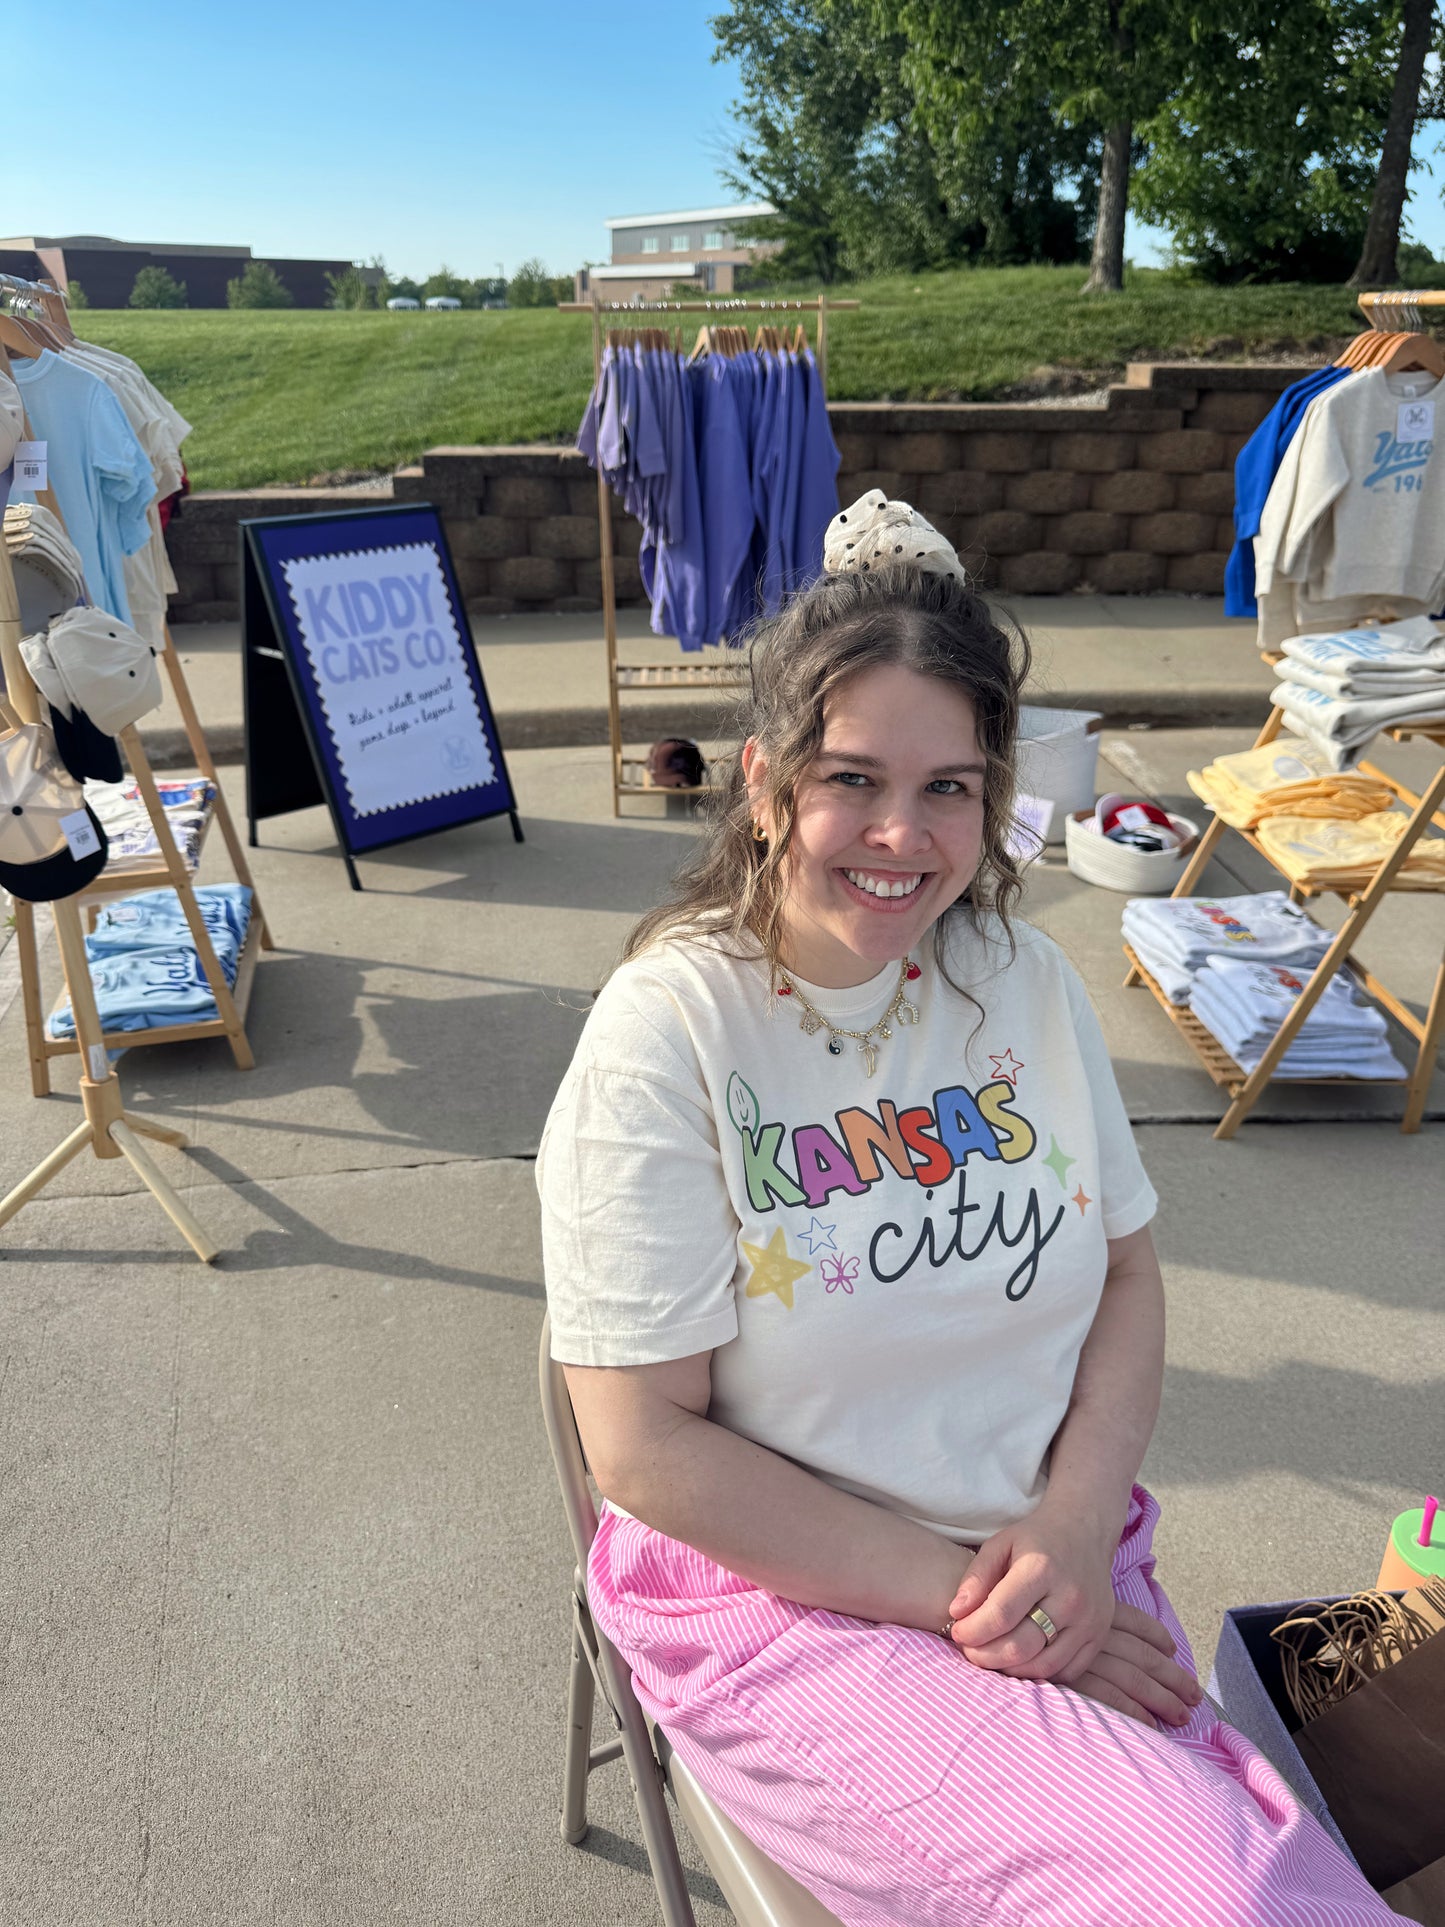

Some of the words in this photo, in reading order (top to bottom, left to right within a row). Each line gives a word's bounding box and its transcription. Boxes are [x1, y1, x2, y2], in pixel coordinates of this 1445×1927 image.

[304, 573, 434, 643] KIDDY
[321, 636, 401, 686] CATS
[404, 628, 455, 670] CO.
[359, 731, 386, 752] game
[421, 696, 457, 723] beyond
[386, 691, 416, 713] adult
[418, 676, 454, 703] apparel
[741, 1079, 1038, 1213] KANSAS
[868, 1169, 1066, 1302] city
